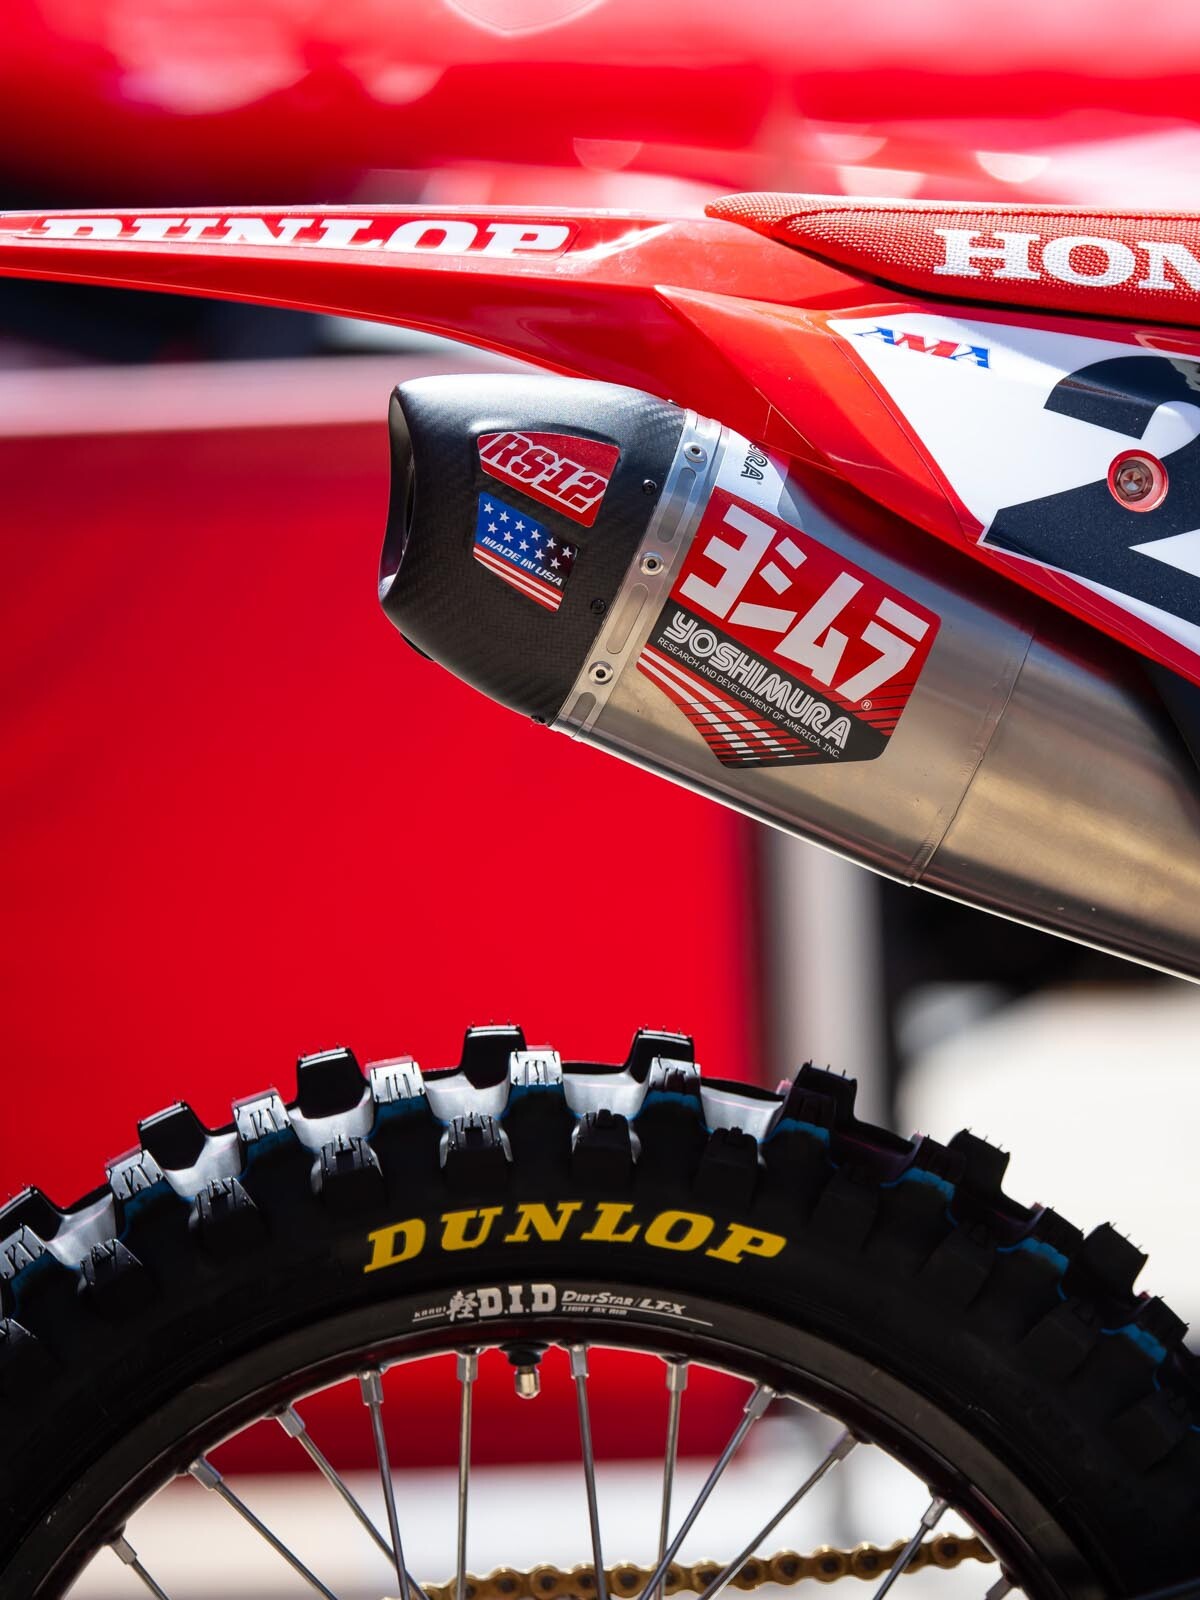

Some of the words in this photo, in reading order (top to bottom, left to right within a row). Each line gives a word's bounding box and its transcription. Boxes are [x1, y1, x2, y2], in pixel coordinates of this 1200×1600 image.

[30, 217, 571, 257] DUNLOP
[855, 326, 990, 369] AMA
[481, 535, 522, 563] MADE
[520, 557, 535, 570] IN
[535, 566, 563, 587] USA
[657, 637, 700, 670] RESEARCH
[698, 664, 718, 680] AND
[716, 675, 773, 714] DEVELOPMENT
[772, 710, 785, 722] OF
[822, 743, 841, 759] INC.
[664, 610, 851, 749] YOSHIMURA
[363, 1202, 787, 1273] DUNLOP
